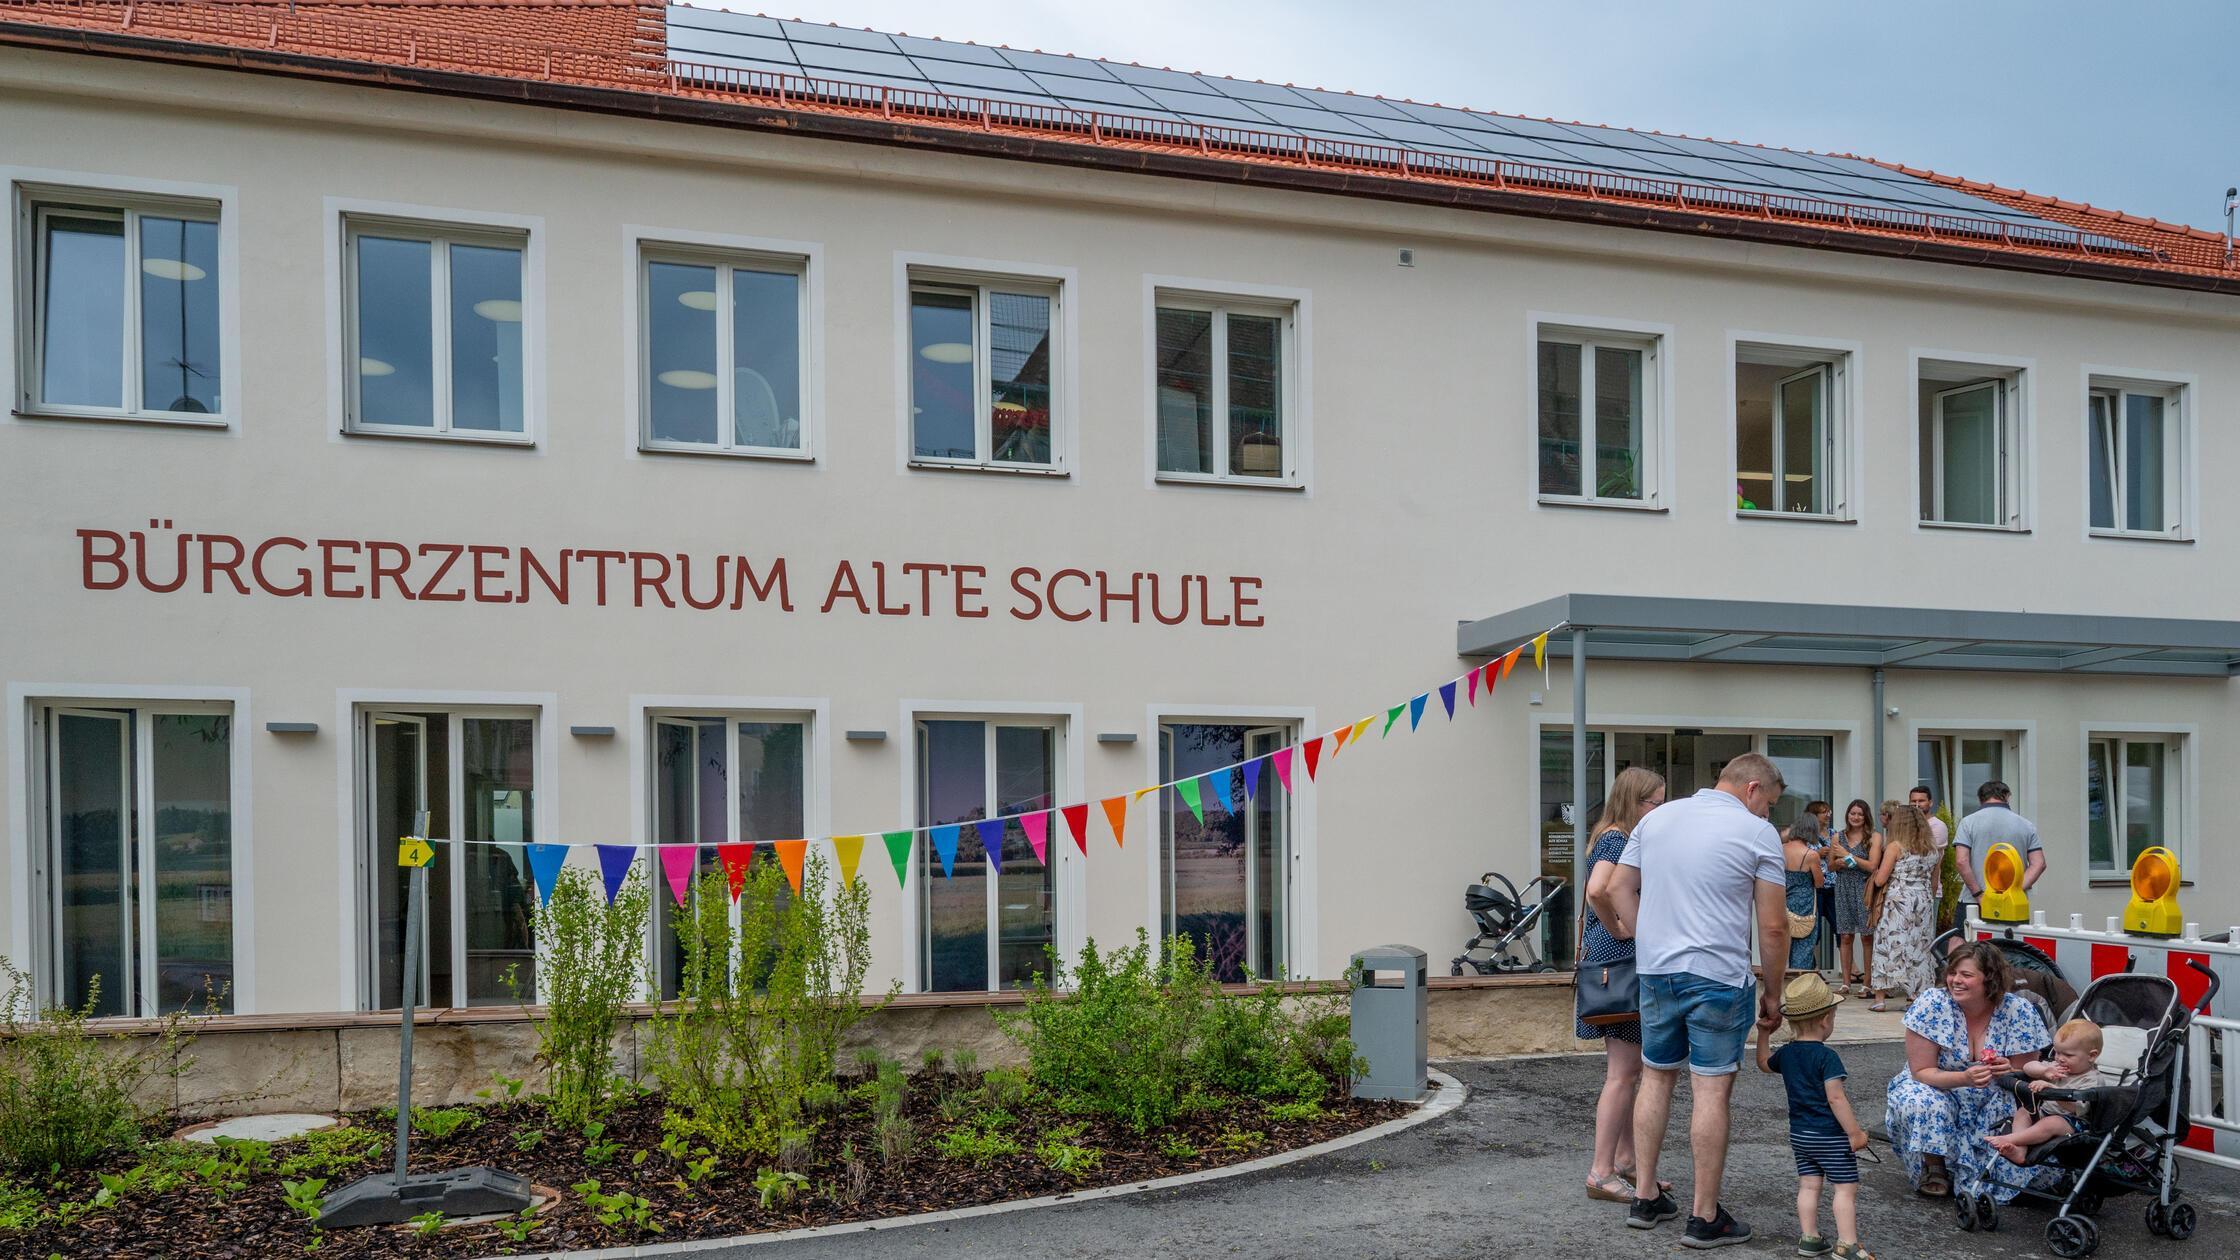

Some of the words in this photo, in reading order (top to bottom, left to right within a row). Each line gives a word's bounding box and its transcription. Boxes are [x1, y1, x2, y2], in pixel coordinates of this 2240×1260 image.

[78, 519, 794, 612] BÜRGERZENTRUM
[820, 559, 989, 618] ALTE
[1010, 566, 1265, 627] SCHULE
[409, 848, 418, 862] 4
